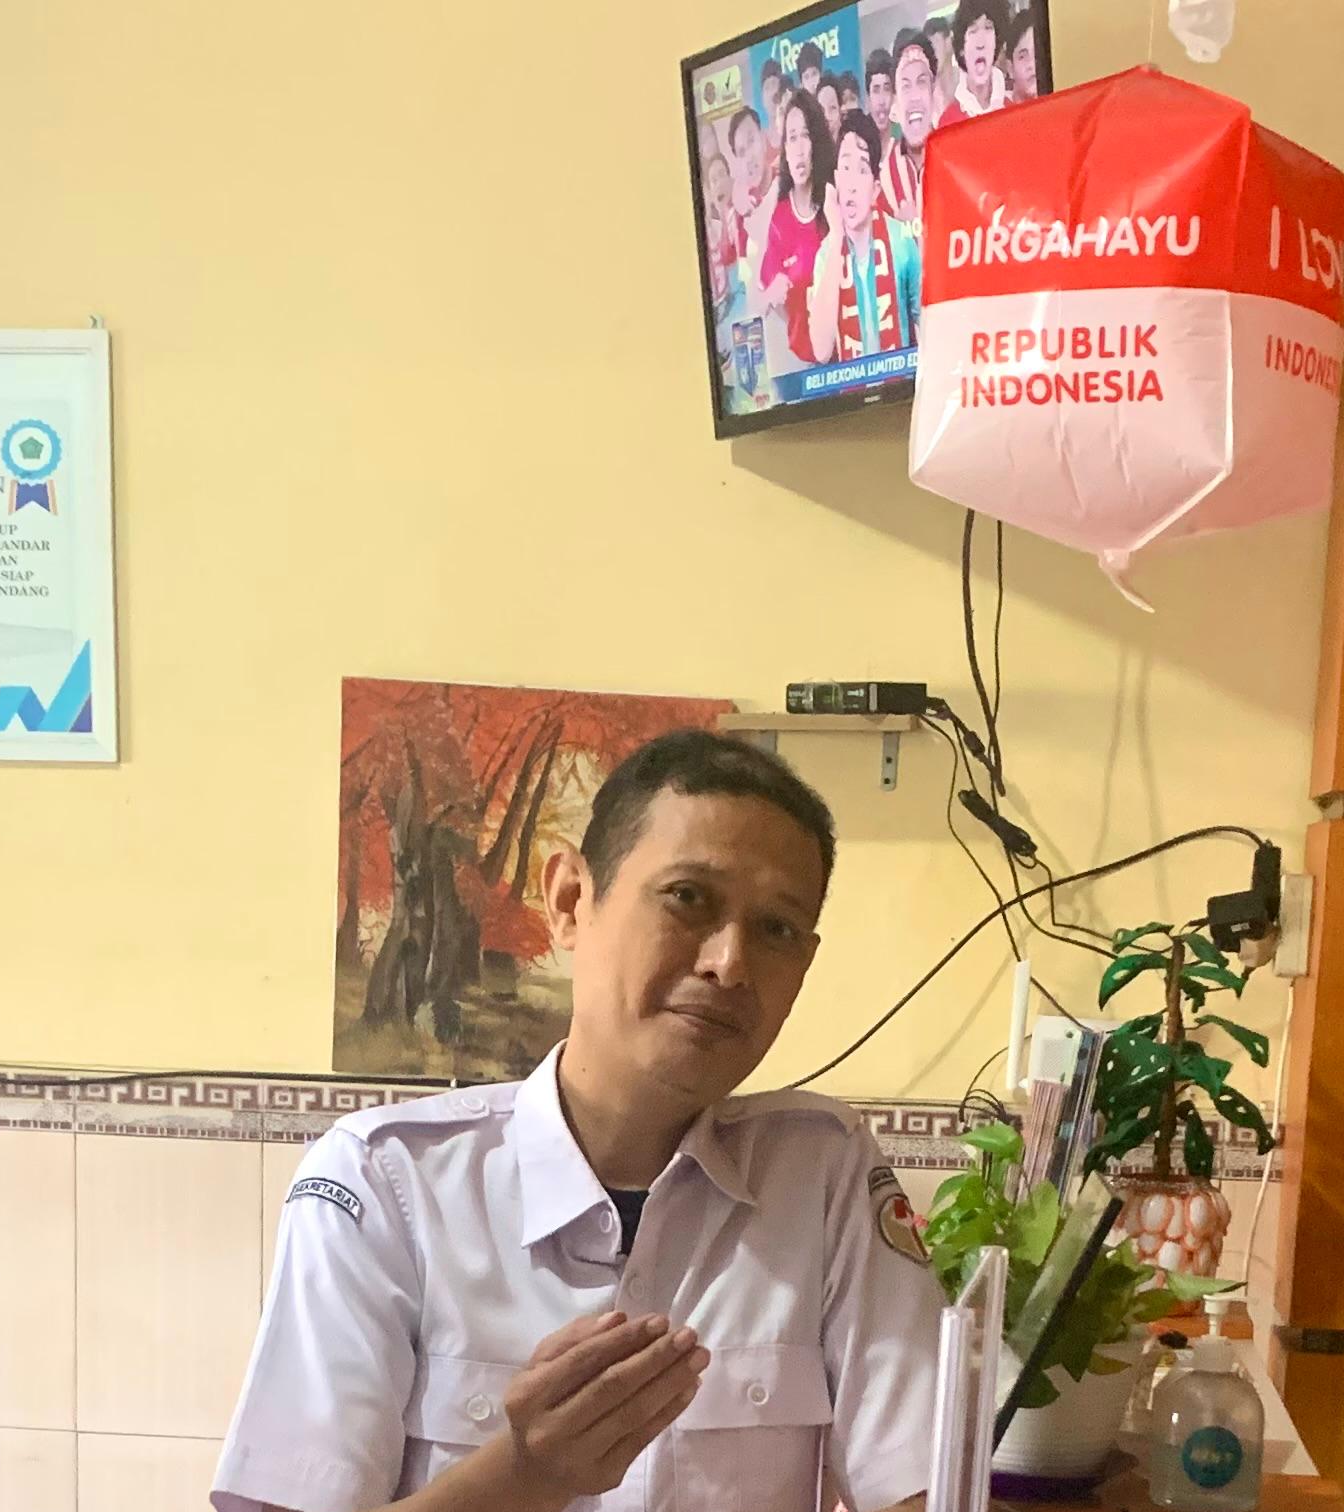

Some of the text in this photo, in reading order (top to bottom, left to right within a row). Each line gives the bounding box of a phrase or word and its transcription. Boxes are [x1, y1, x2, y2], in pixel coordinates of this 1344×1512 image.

[779, 26, 840, 75] Rena
[948, 214, 1200, 269] DIRGAHAYU
[1269, 204, 1281, 271] I
[971, 324, 1159, 364] REPUBLIK
[805, 374, 825, 390] BELI
[826, 363, 867, 386] REXONA
[867, 354, 906, 377] LIMITED
[961, 369, 1164, 410] INDONESIA
[0, 570, 35, 582] SIAP
